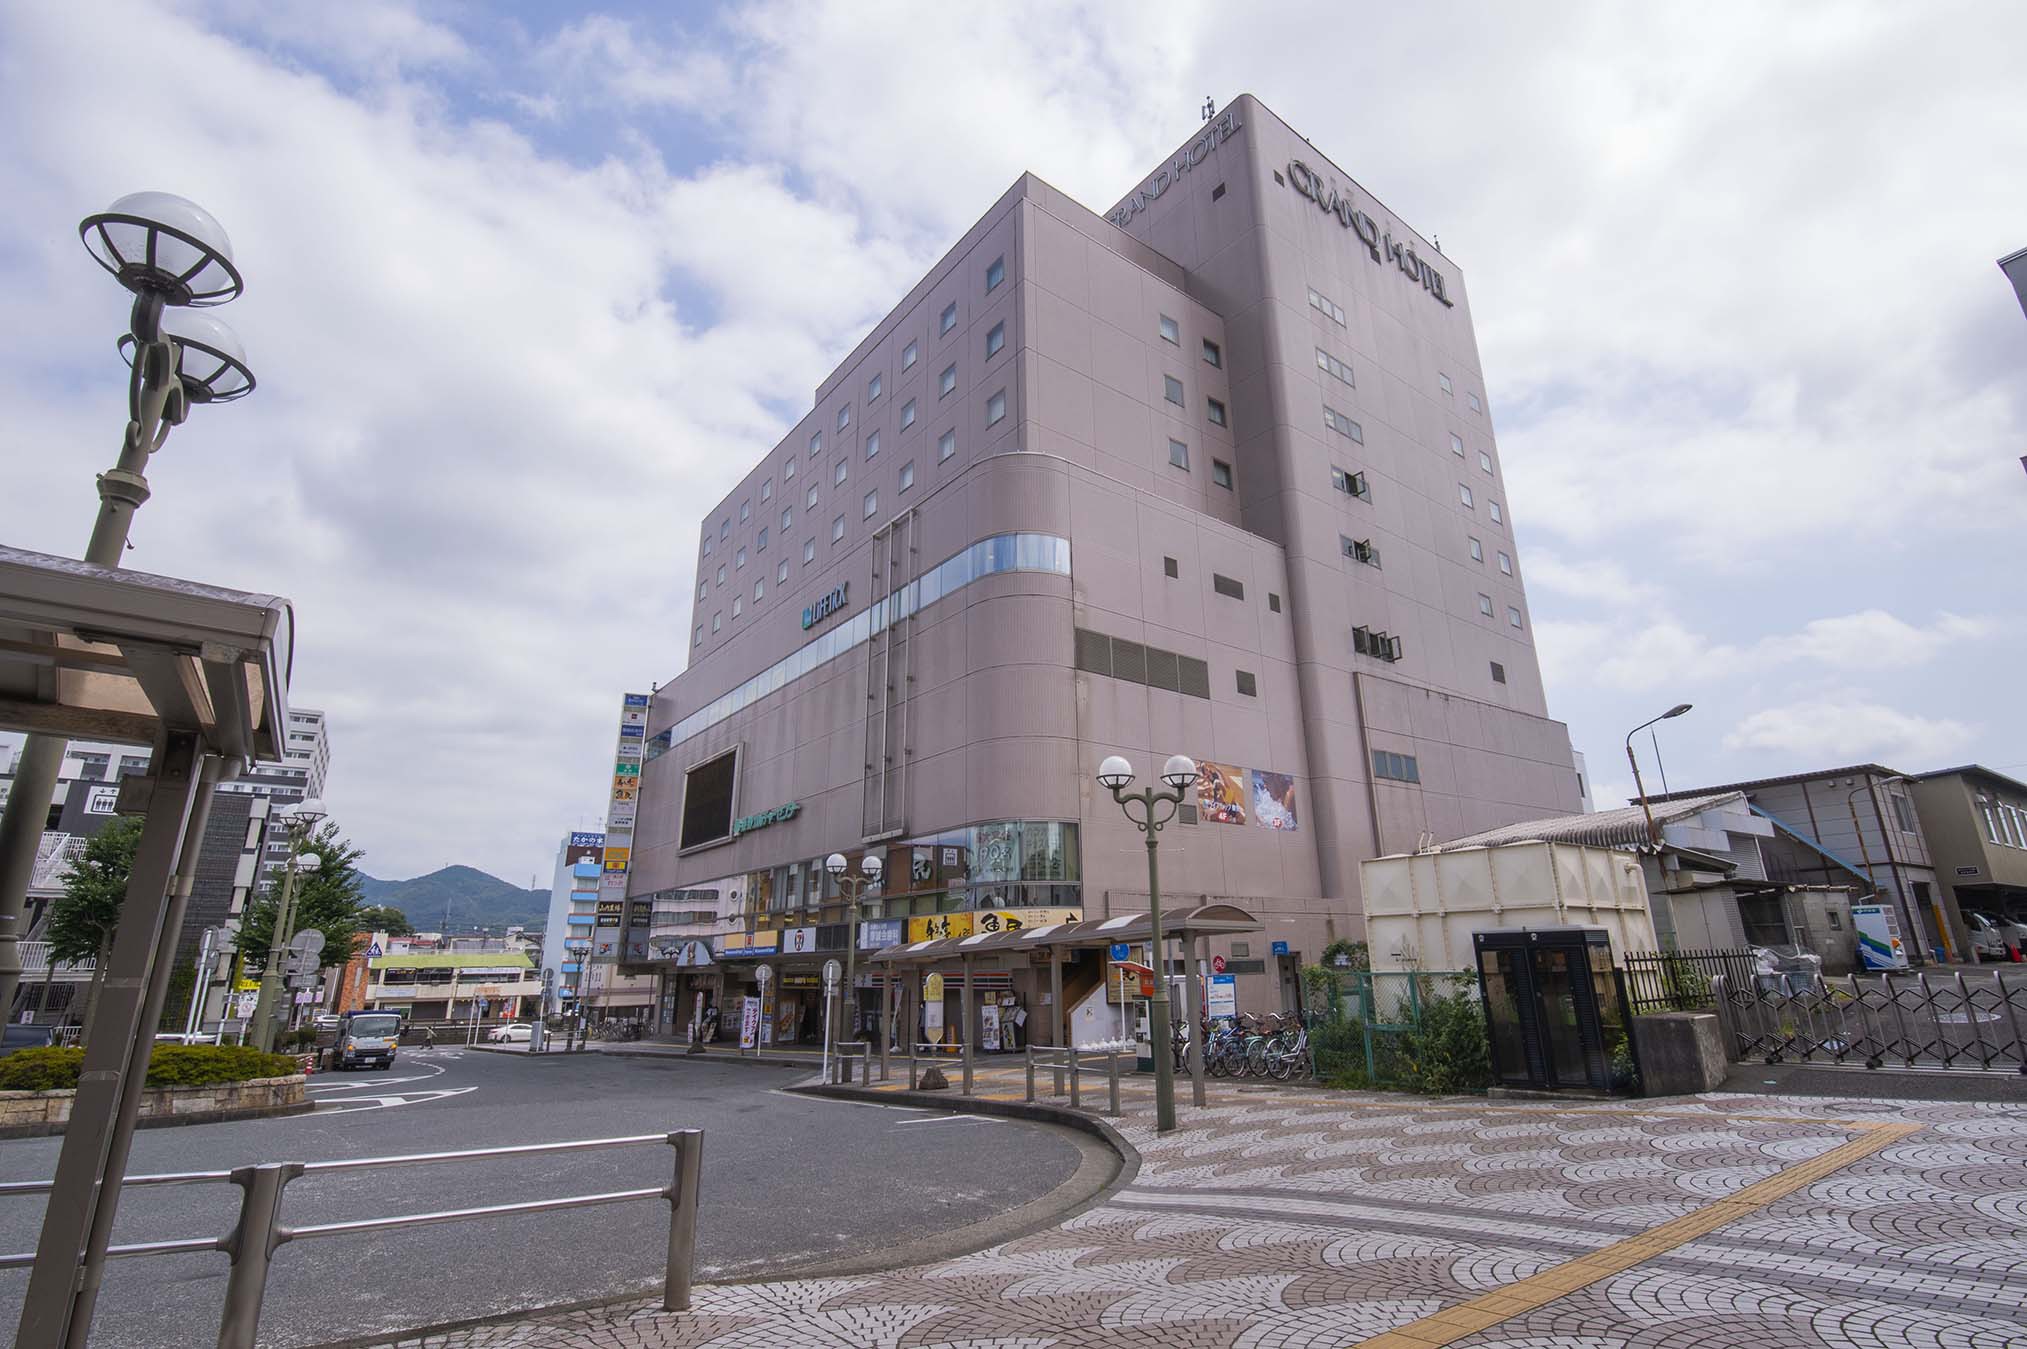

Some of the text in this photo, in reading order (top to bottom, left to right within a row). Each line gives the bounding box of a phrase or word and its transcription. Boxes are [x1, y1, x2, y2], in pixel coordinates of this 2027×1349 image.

[1110, 112, 1243, 228] RAND HOTEL
[1287, 159, 1454, 308] GRAND HOTEL
